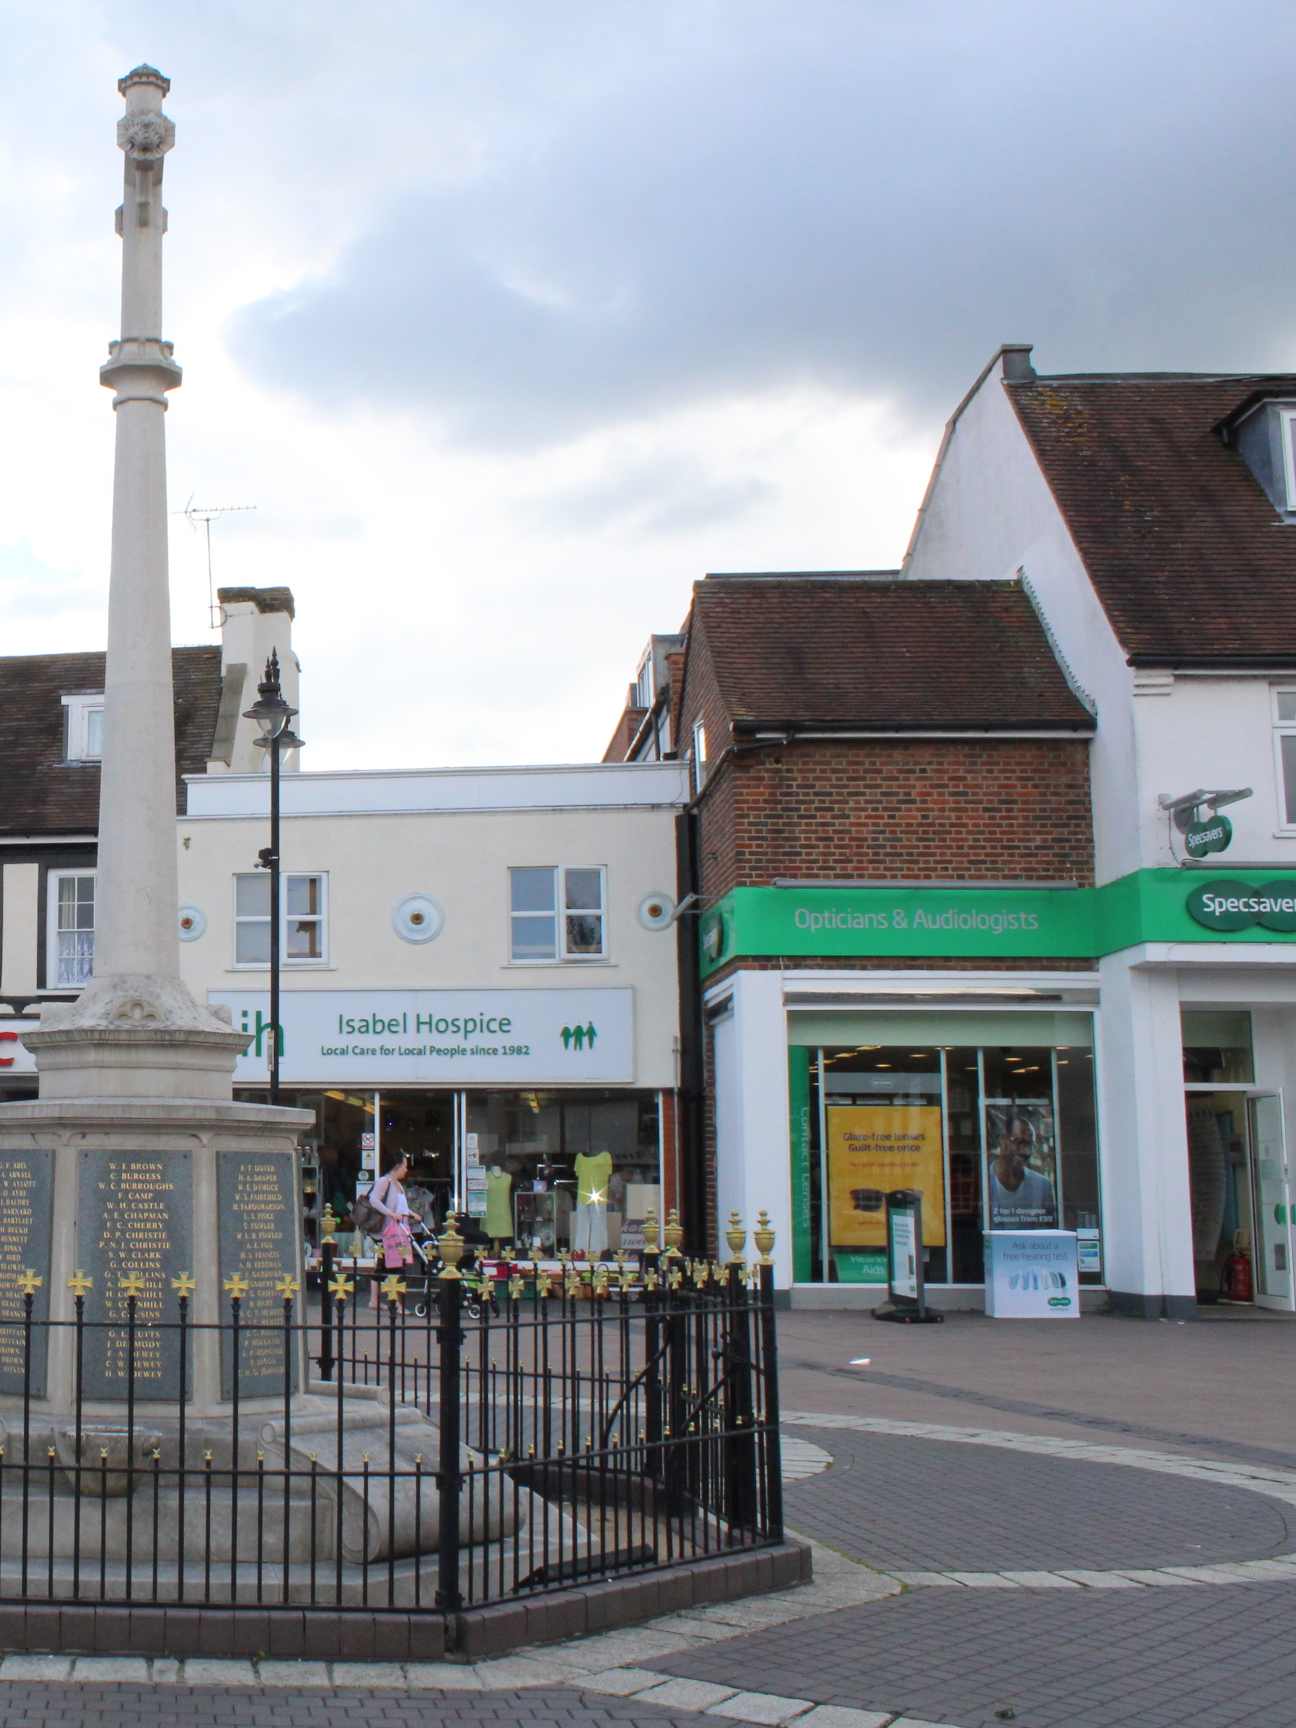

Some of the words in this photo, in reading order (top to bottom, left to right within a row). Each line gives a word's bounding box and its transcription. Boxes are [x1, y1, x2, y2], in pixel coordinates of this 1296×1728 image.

[1187, 826, 1223, 849] Specsavers
[794, 908, 888, 932] Opticians
[892, 909, 908, 929] &
[913, 908, 1039, 934] Audiologists
[339, 1012, 407, 1035] Isabel
[416, 1012, 512, 1040] Hospice
[321, 1045, 349, 1056] Local
[351, 1045, 377, 1056] Care
[379, 1044, 396, 1056] for
[398, 1045, 426, 1056] Local
[429, 1045, 467, 1058] People
[470, 1045, 499, 1056] since
[501, 1045, 530, 1056] 1982
[843, 1132, 892, 1142] Glare-free
[894, 1132, 926, 1142] lenses
[848, 1143, 895, 1153] Guilt-free
[896, 1143, 921, 1154] price
[122, 1172, 162, 1180] BURGESS
[120, 1182, 174, 1190] BURROUGHS
[128, 1192, 154, 1200] CAMP
[131, 1202, 165, 1210] CASTLE
[124, 1212, 169, 1220] CHAPMAN
[993, 1207, 998, 1215] 2
[999, 1207, 1010, 1215] for
[1015, 1207, 1046, 1216] designer
[1039, 1215, 1053, 1223] £99
[130, 1241, 171, 1249] CHRISTIE
[1012, 1242, 1027, 1250] Ask
[1028, 1241, 1052, 1250] about
[1003, 1252, 1020, 1261] free
[1021, 1252, 1051, 1262] hearing
[1052, 1252, 1068, 1261] test
[862, 1264, 885, 1275] Aids
[116, 1340, 161, 1348] DEMODY
